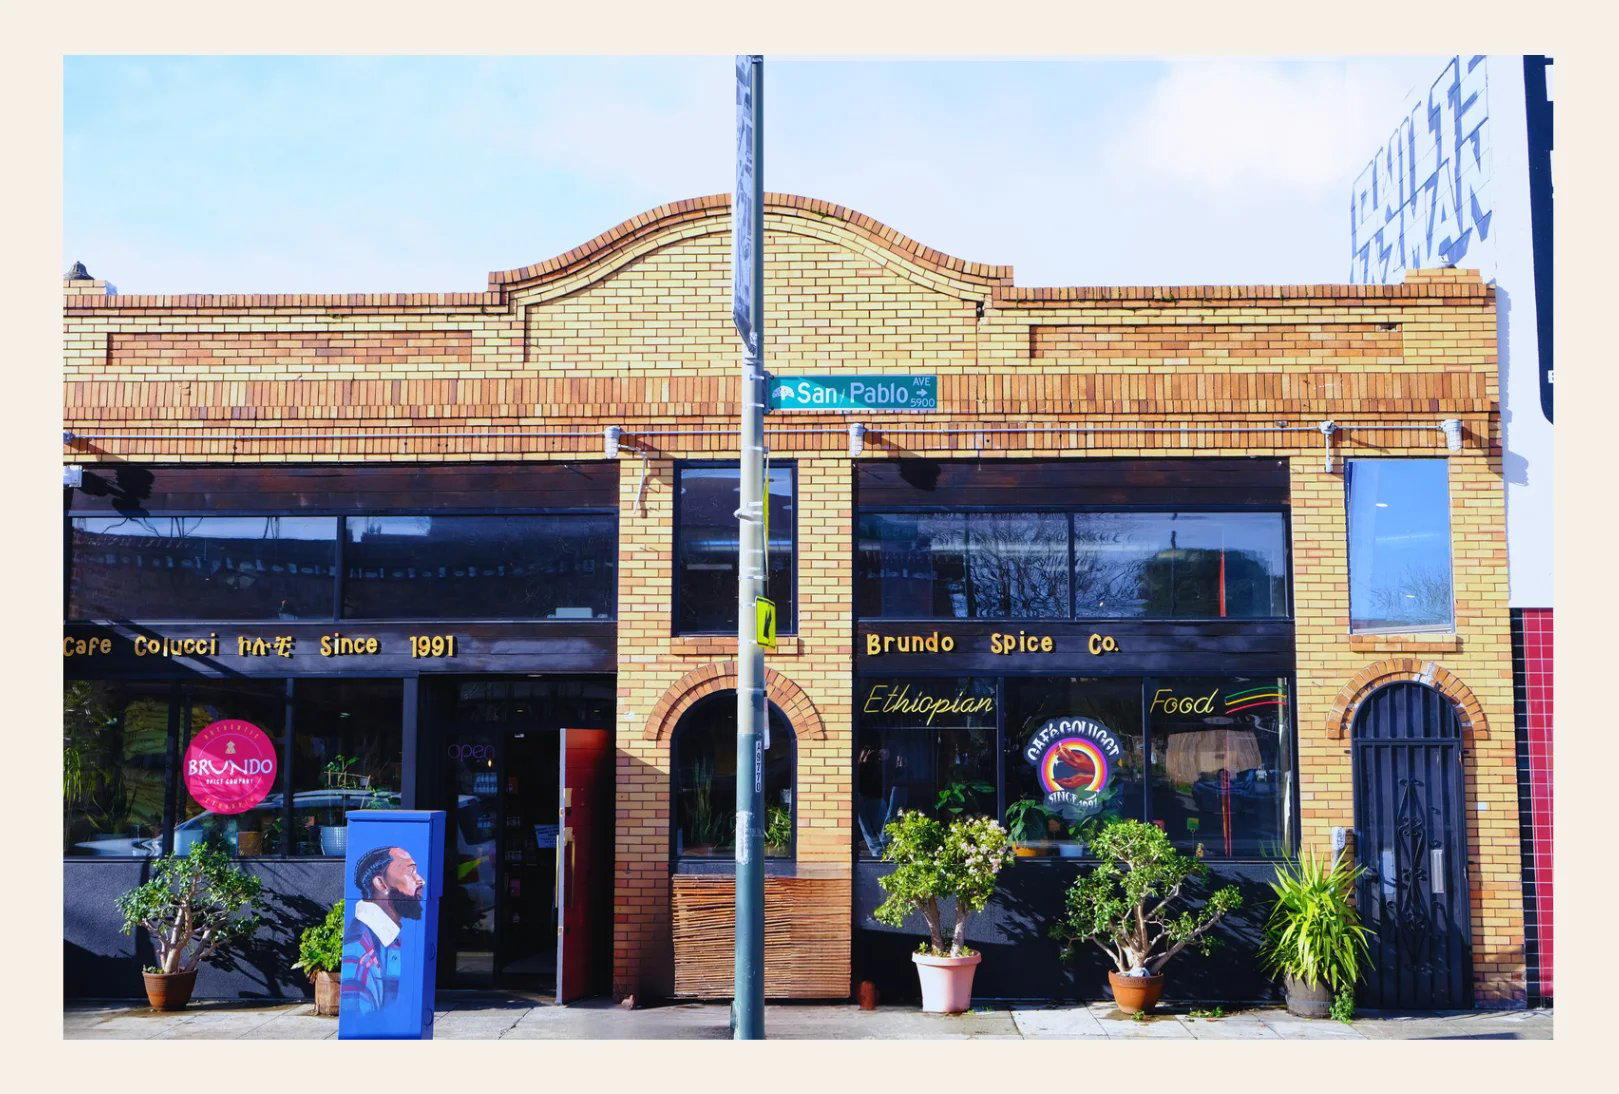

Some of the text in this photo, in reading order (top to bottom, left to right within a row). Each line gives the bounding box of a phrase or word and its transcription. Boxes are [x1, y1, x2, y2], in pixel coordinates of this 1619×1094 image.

[797, 382, 909, 404] San Pablo
[912, 377, 931, 387] AVE
[910, 397, 935, 408] 5900
[63, 632, 216, 657] Cafe Colucci
[320, 632, 454, 658] Since 1991
[866, 631, 1120, 655] Brundo Spice Co.
[863, 683, 994, 727] Ethiopian
[1149, 687, 1220, 715] Food
[188, 758, 273, 775] BRUNDO
